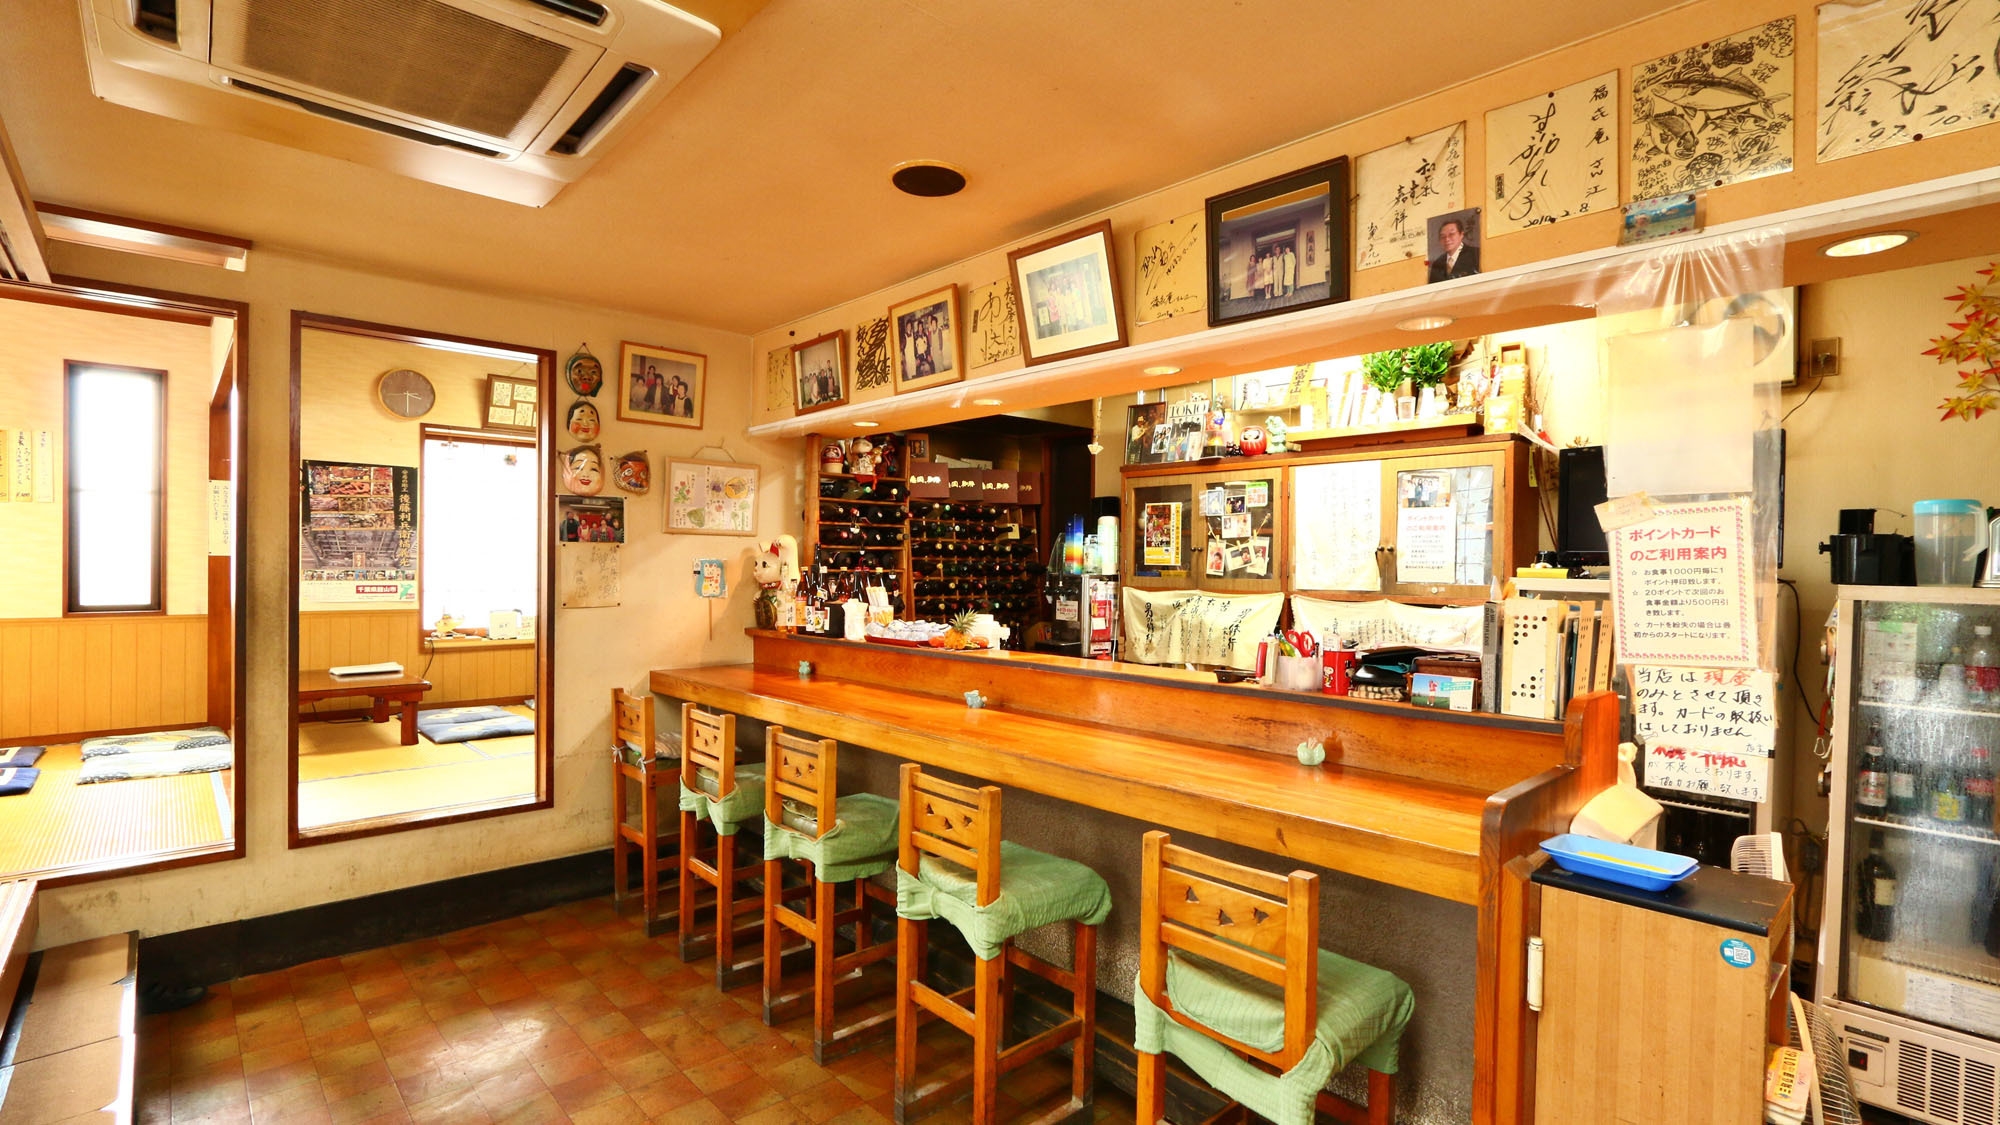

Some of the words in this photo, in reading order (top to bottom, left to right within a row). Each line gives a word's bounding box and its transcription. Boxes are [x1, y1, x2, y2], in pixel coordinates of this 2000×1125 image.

[1169, 403, 1207, 418] TOKIO
[1628, 525, 1721, 541] ポイントカード
[1630, 546, 1727, 561] のご利用案内
[1638, 667, 1752, 687] 当店は現金
[1637, 688, 1763, 707] のみとさせて頂き
[1639, 722, 1752, 737] はしておりません
